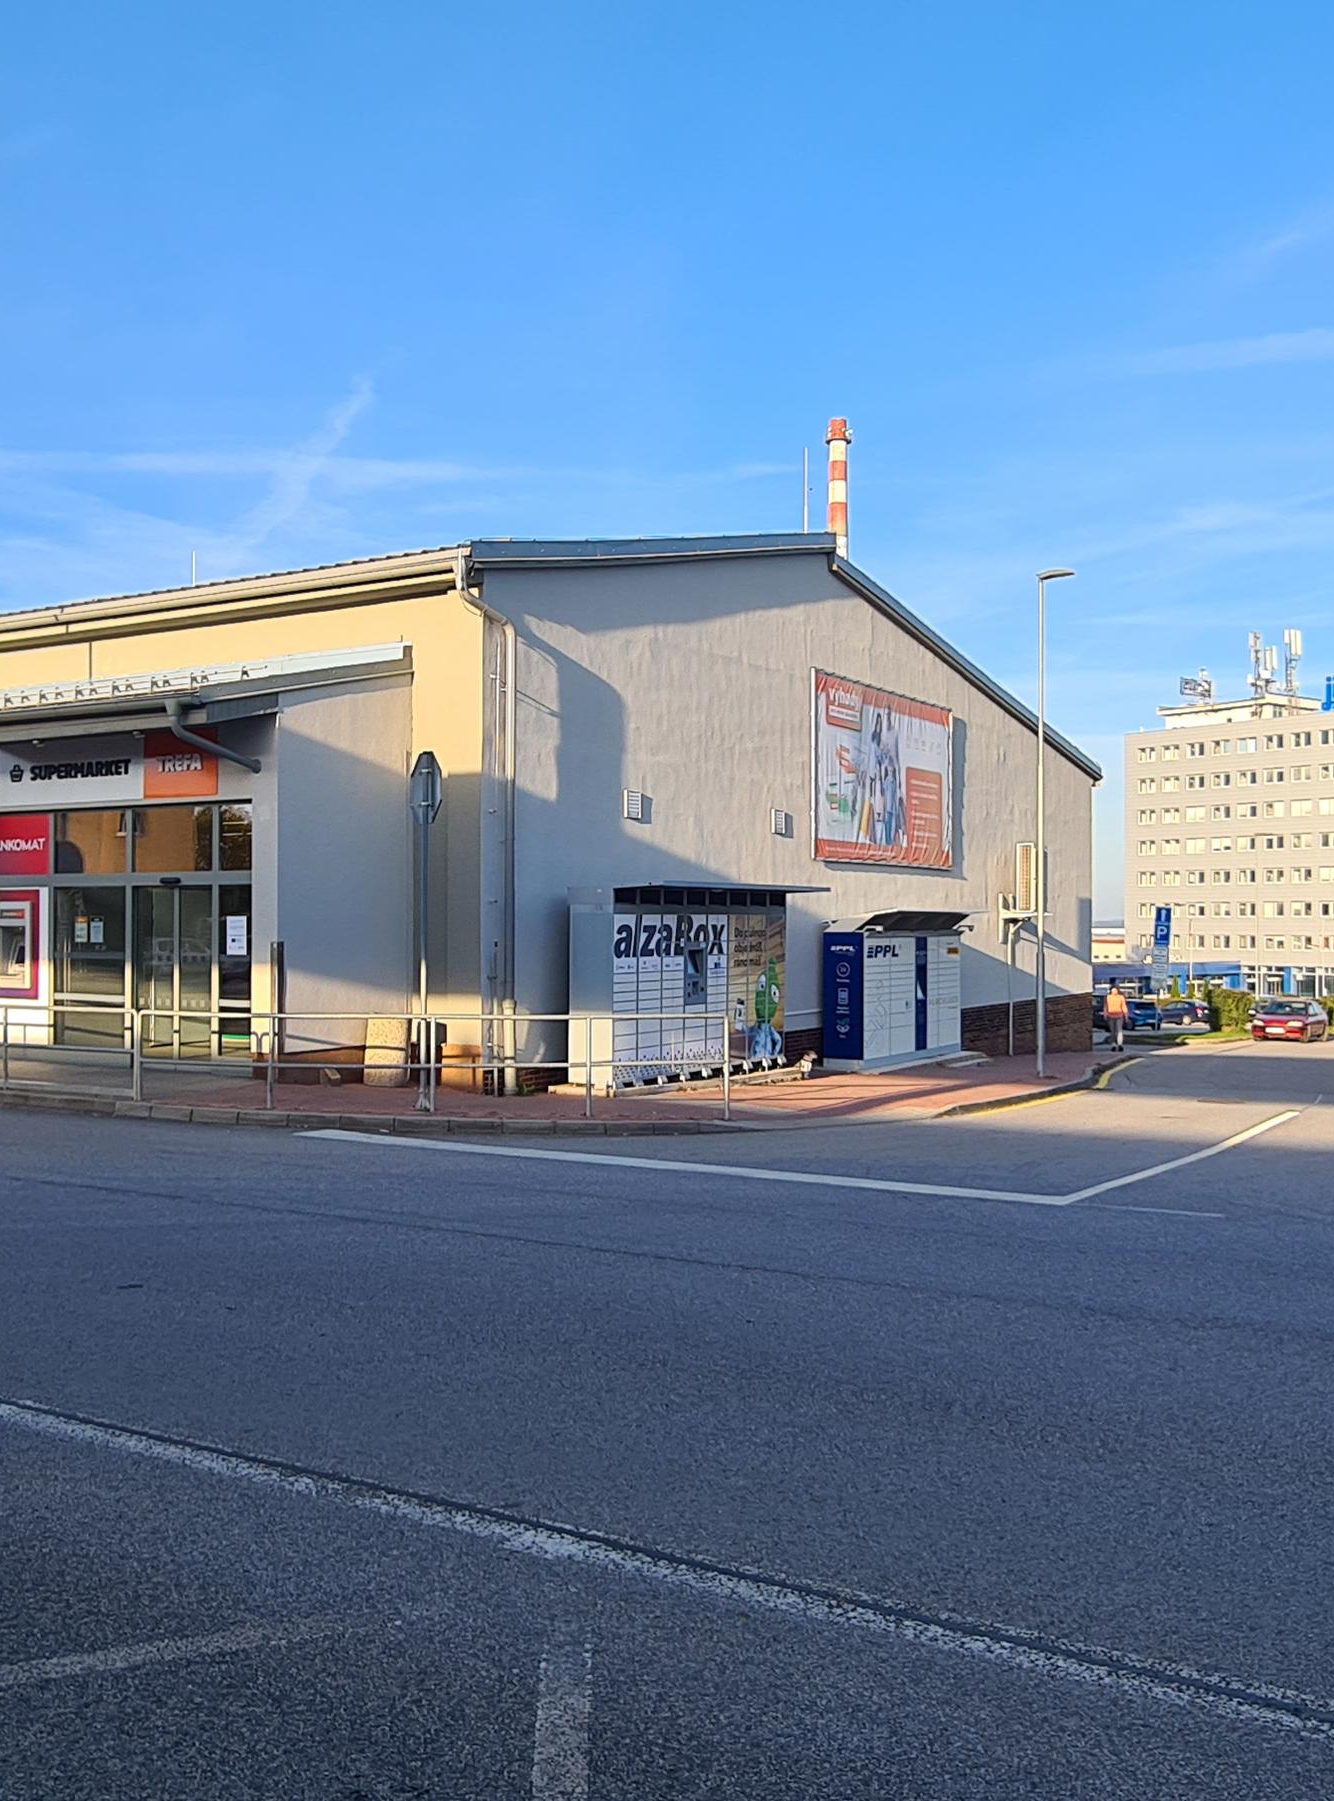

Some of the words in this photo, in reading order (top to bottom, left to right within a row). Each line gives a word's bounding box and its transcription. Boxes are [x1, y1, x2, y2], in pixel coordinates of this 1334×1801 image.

[30, 758, 131, 781] SUPERMARKET
[156, 753, 203, 773] TREFA
[614, 915, 725, 958] alzaBox
[1156, 926, 1167, 939] P
[874, 944, 899, 958] PPL
